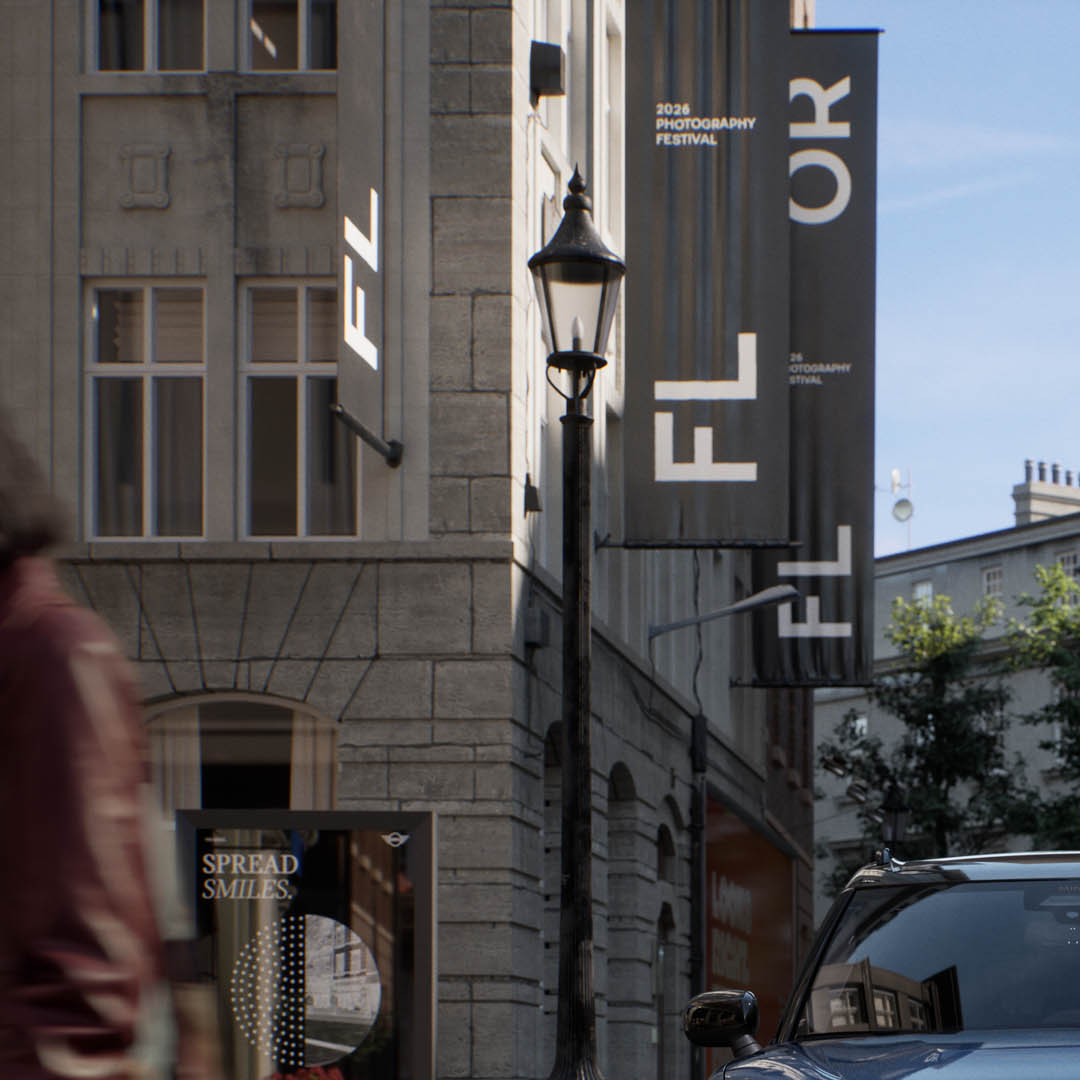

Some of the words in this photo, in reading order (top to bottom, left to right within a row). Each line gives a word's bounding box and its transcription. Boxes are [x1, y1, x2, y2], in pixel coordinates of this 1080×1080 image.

[656, 102, 691, 115] 2026
[656, 116, 757, 131] PHOTOGRAPHY
[656, 132, 718, 146] FESTIVAL
[344, 187, 379, 372] FL
[655, 332, 757, 482] FL
[777, 525, 852, 638] FL
[201, 853, 299, 875] SPREAD
[201, 877, 294, 900] SMILES.
